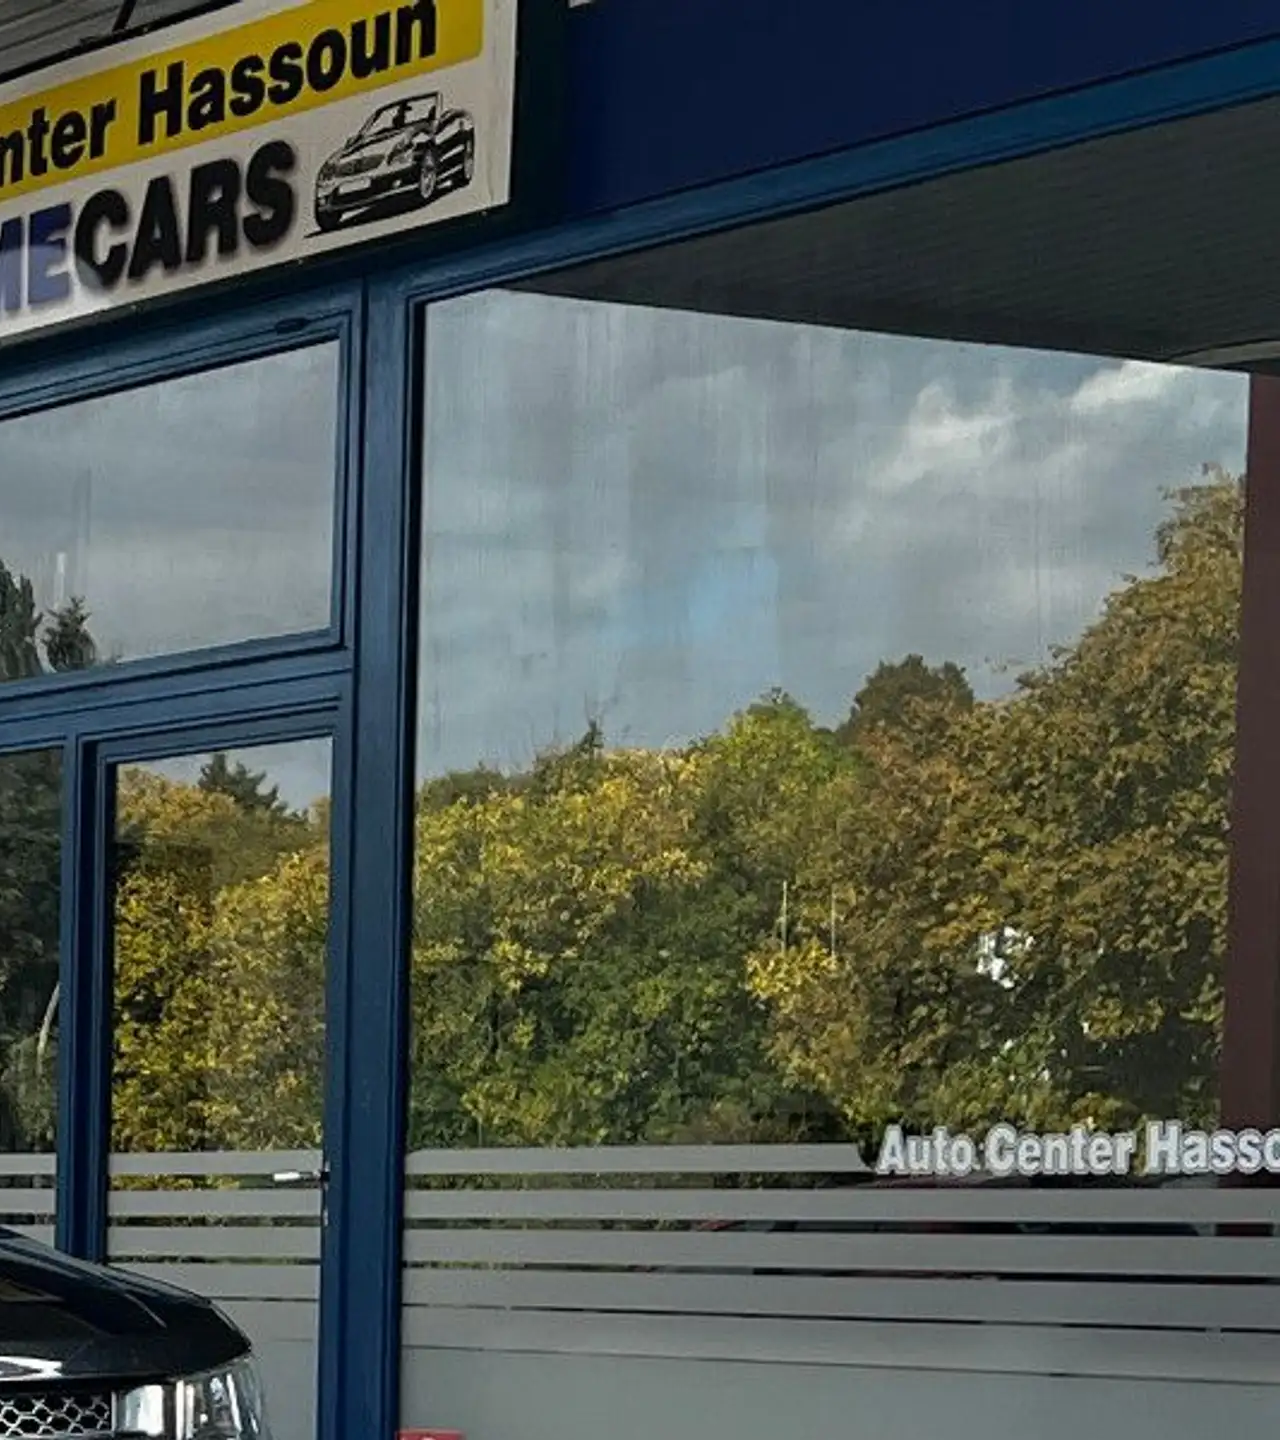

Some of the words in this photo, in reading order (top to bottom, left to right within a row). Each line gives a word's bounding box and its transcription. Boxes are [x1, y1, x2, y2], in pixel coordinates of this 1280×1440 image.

[138, 0, 437, 144] Hassoun
[876, 1123, 978, 1175] Auto
[986, 1121, 1136, 1176] Center
